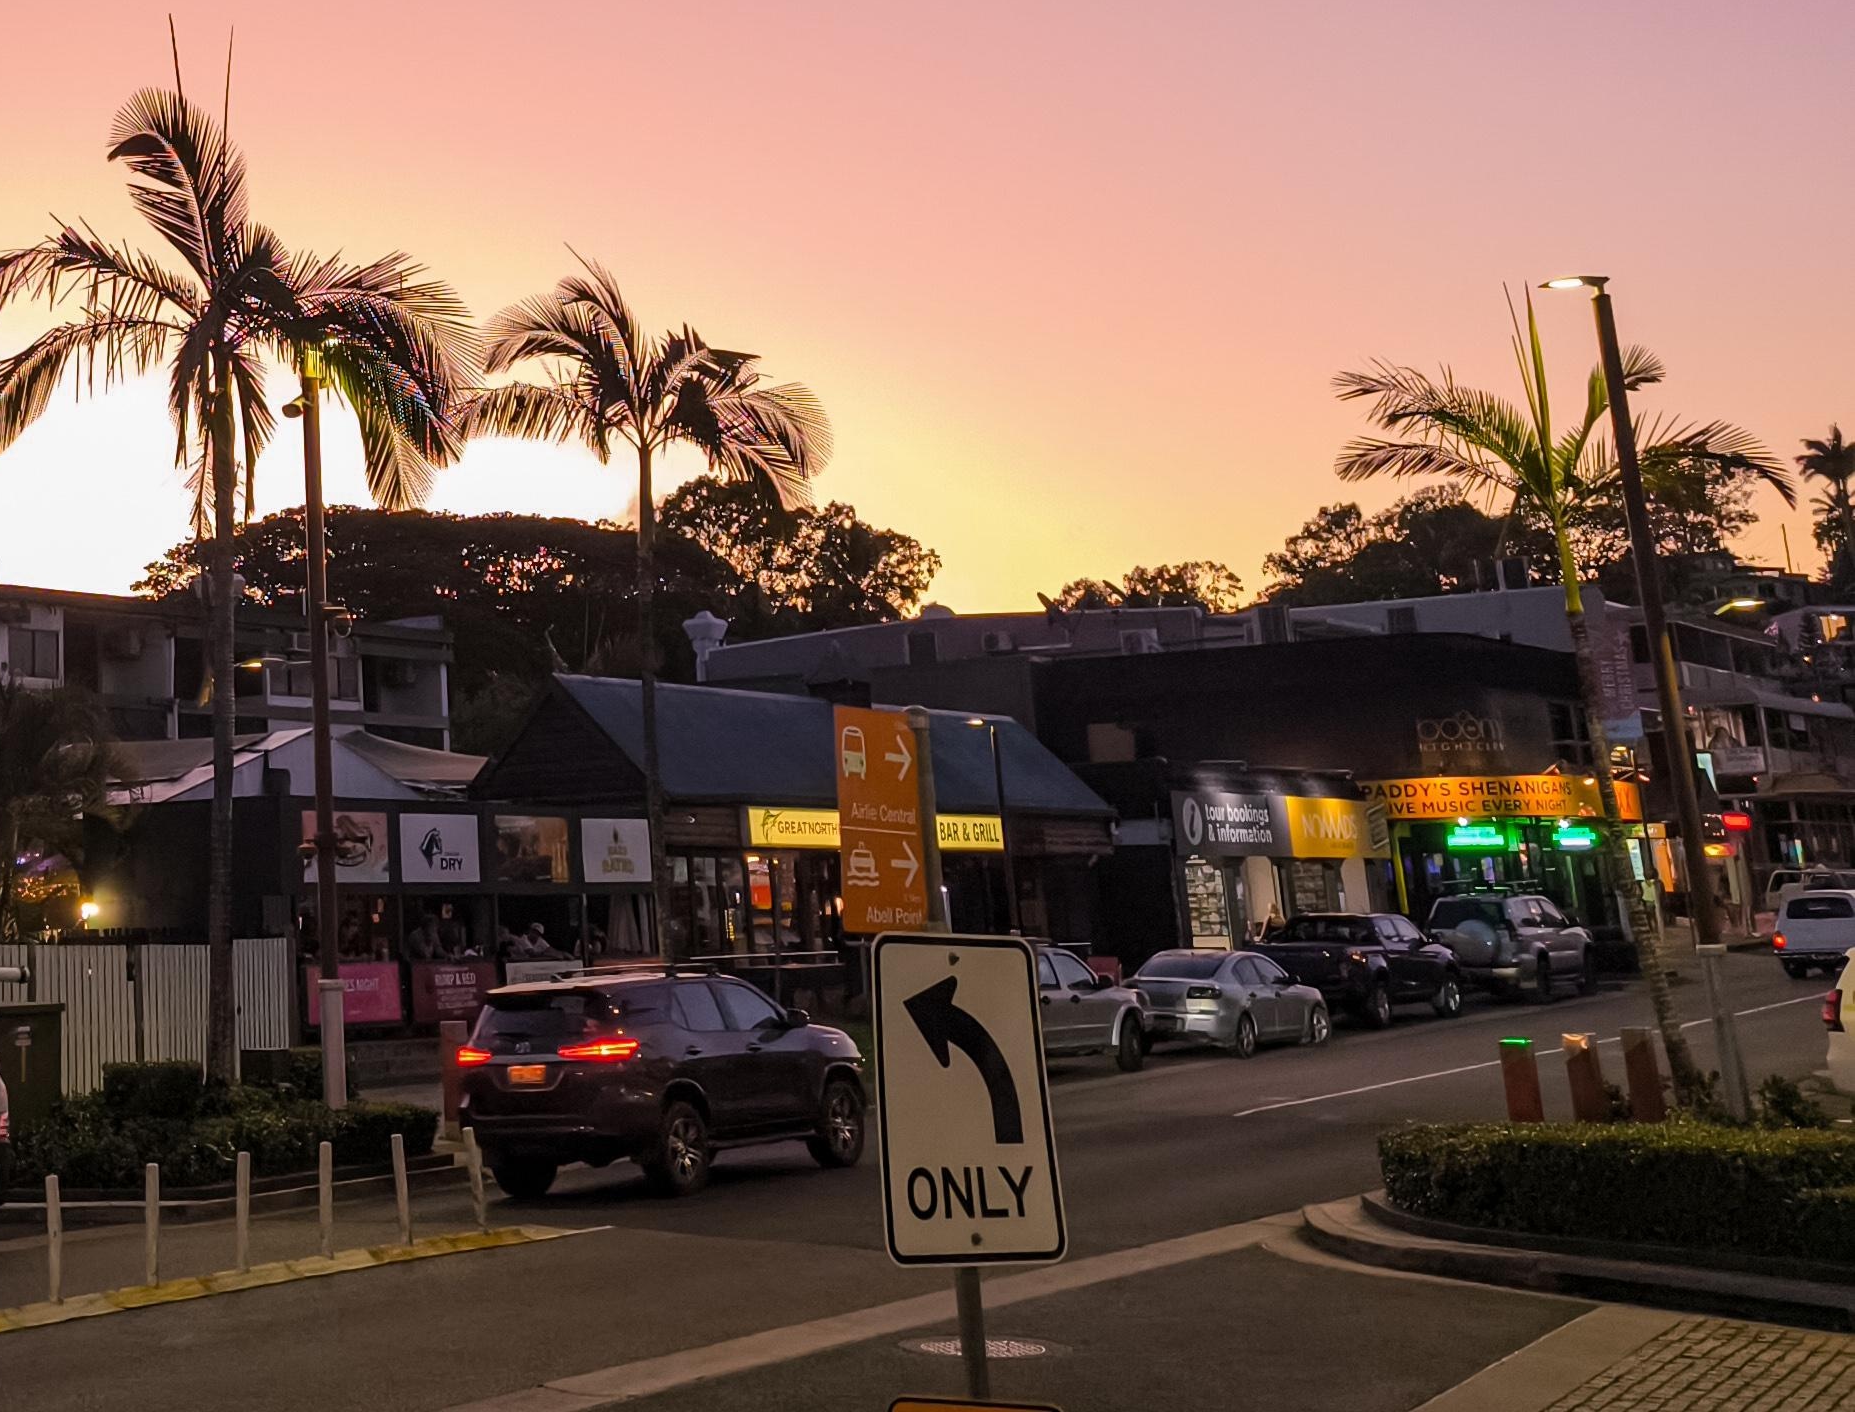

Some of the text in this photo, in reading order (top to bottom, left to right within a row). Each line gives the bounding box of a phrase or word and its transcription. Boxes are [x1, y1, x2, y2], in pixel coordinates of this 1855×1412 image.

[1360, 780, 1572, 798] PADDY'S SHENANIGANS
[851, 801, 917, 825] Airlie Central
[1204, 803, 1270, 824] tour bookings
[1388, 798, 1567, 814] IVE MUSIC EVERY NIGHT
[939, 822, 959, 842] BAR
[962, 823, 972, 841] &
[973, 823, 1000, 843] GRILL
[1208, 823, 1273, 844] & information
[440, 857, 463, 871] DRY
[896, 908, 923, 926] Point
[907, 1166, 1033, 1220] ONLY
